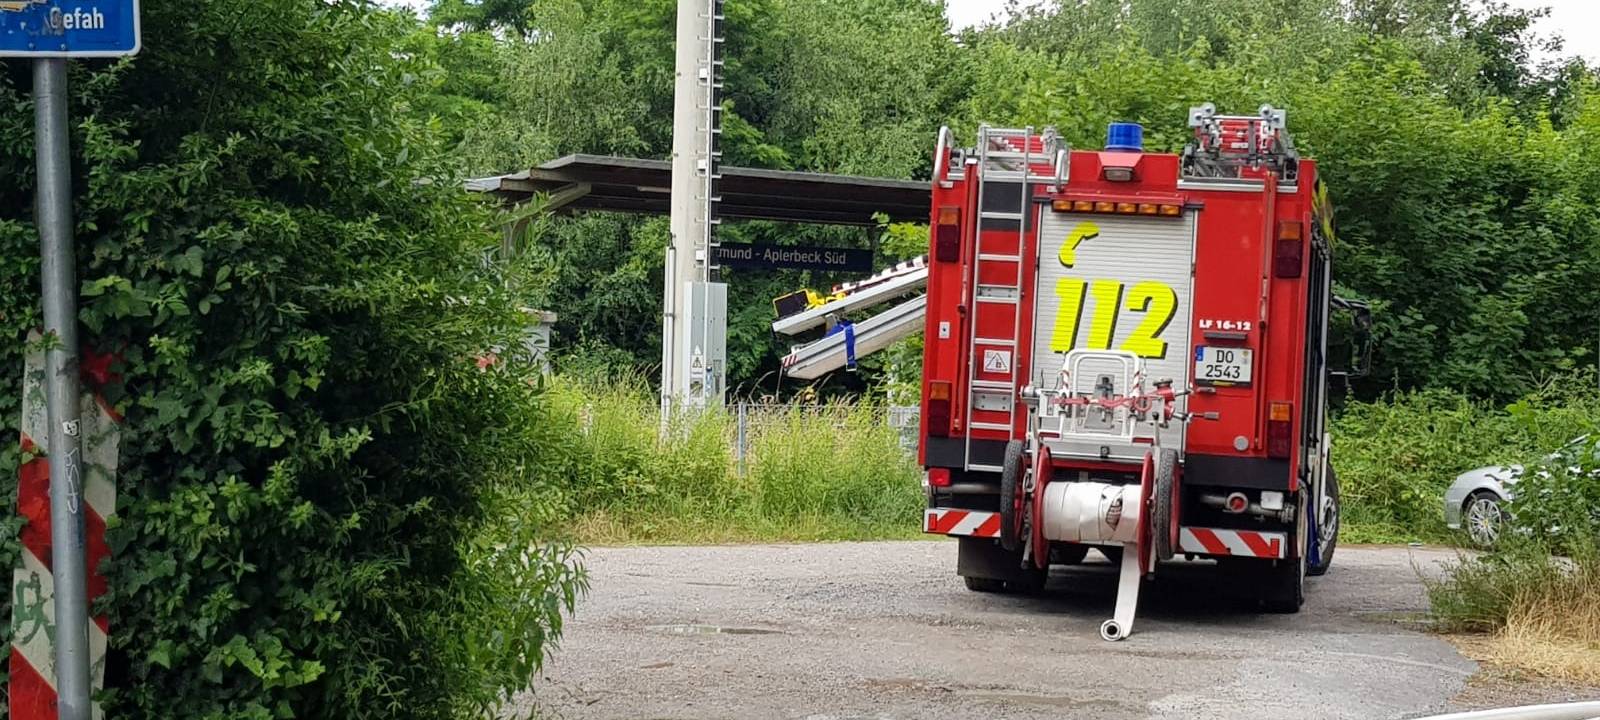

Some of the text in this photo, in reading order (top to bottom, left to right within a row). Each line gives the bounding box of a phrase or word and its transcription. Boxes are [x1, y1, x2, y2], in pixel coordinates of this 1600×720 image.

[763, 248, 822, 264] Aplerbeck
[824, 250, 847, 265] Süd
[1049, 276, 1179, 360] 112
[1199, 319, 1252, 331] LF 16-12
[1216, 349, 1235, 364] DO
[1205, 364, 1241, 379] 2543
